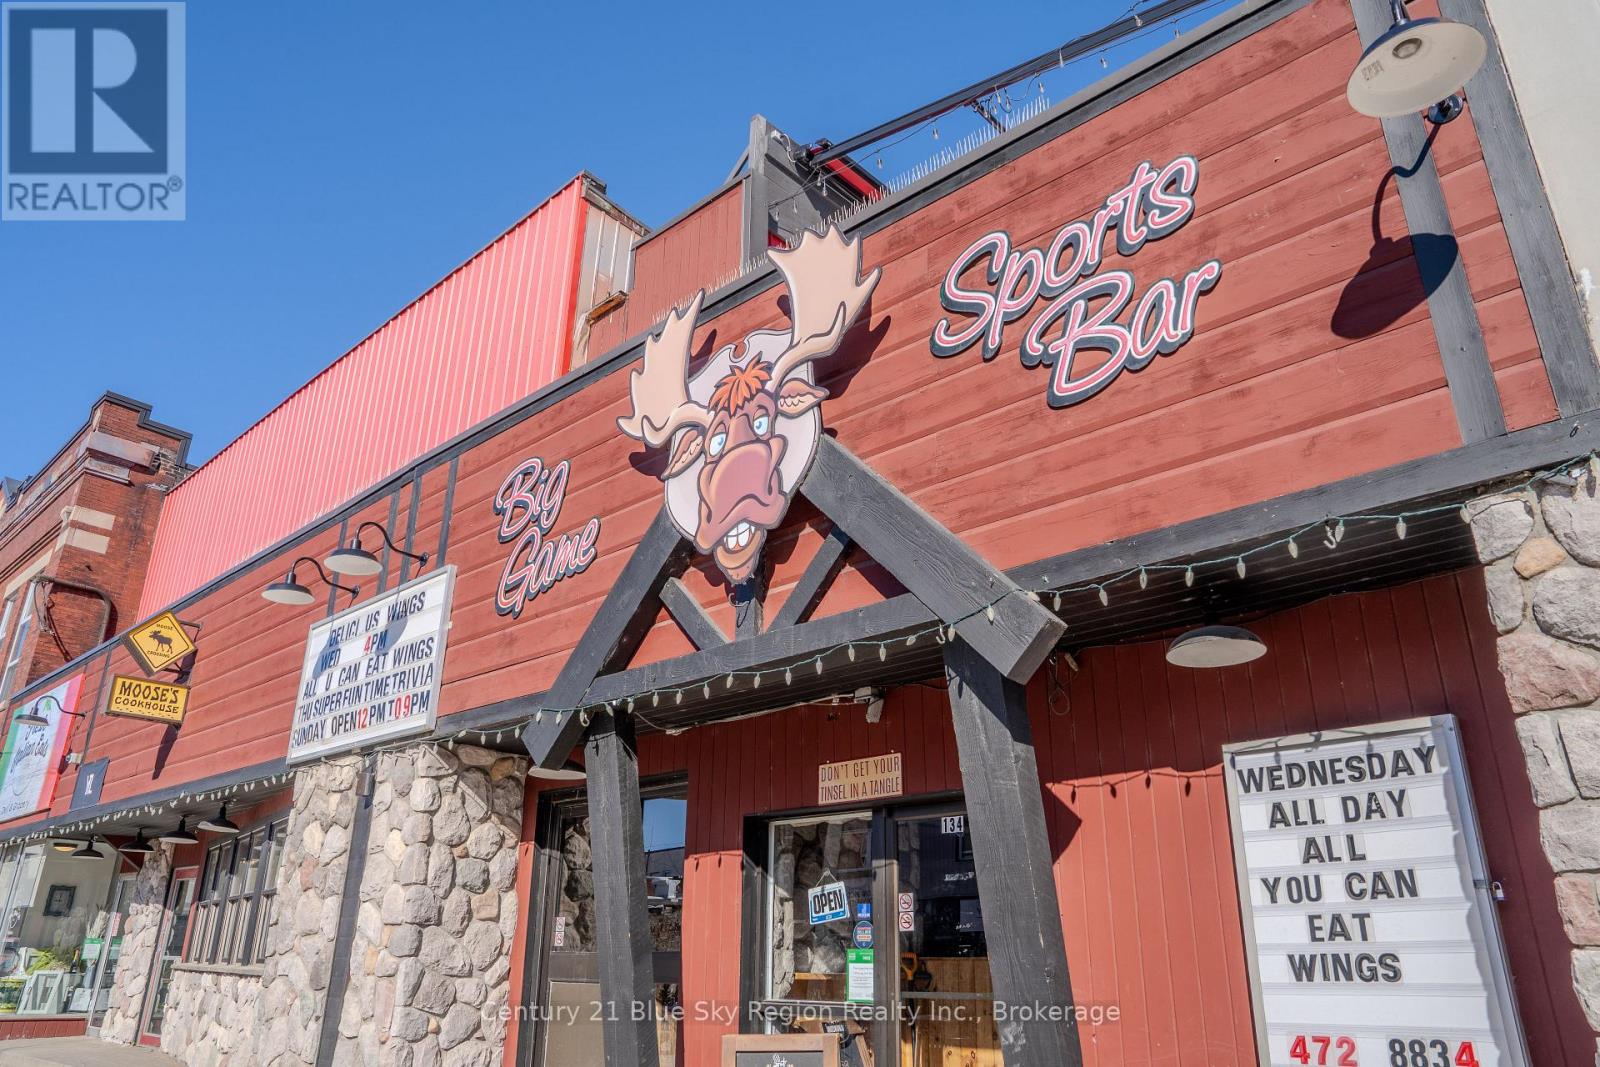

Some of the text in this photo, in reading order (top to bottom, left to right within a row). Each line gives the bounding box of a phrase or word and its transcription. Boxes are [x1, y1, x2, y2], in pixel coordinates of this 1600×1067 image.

[930, 154, 1199, 360] Sports
[1020, 259, 1222, 409] Bar
[493, 457, 571, 543] Big
[496, 526, 601, 619] Game
[387, 591, 426, 622] WINGS
[320, 629, 388, 674] WED 4PM
[302, 636, 434, 701] ALL U CAN EAT WINGS
[114, 696, 180, 714] COOKHOUSE
[119, 680, 180, 705] MOOSE'S
[292, 719, 327, 749] SUNDAY
[821, 756, 900, 782] DON'T GET YOUR
[1237, 745, 1436, 794] WEDNESDAY
[820, 776, 900, 802] TINSEL IN A TANGLE
[943, 816, 963, 833] 134
[1269, 788, 1407, 829] ALL DAY
[1302, 833, 1367, 865] ALL
[812, 888, 844, 915] OPEN
[1261, 868, 1419, 904] YOU CAN
[1307, 912, 1372, 943] EAT
[1287, 952, 1402, 983] WINGS
[1289, 1035, 1480, 1067] 472 8834
